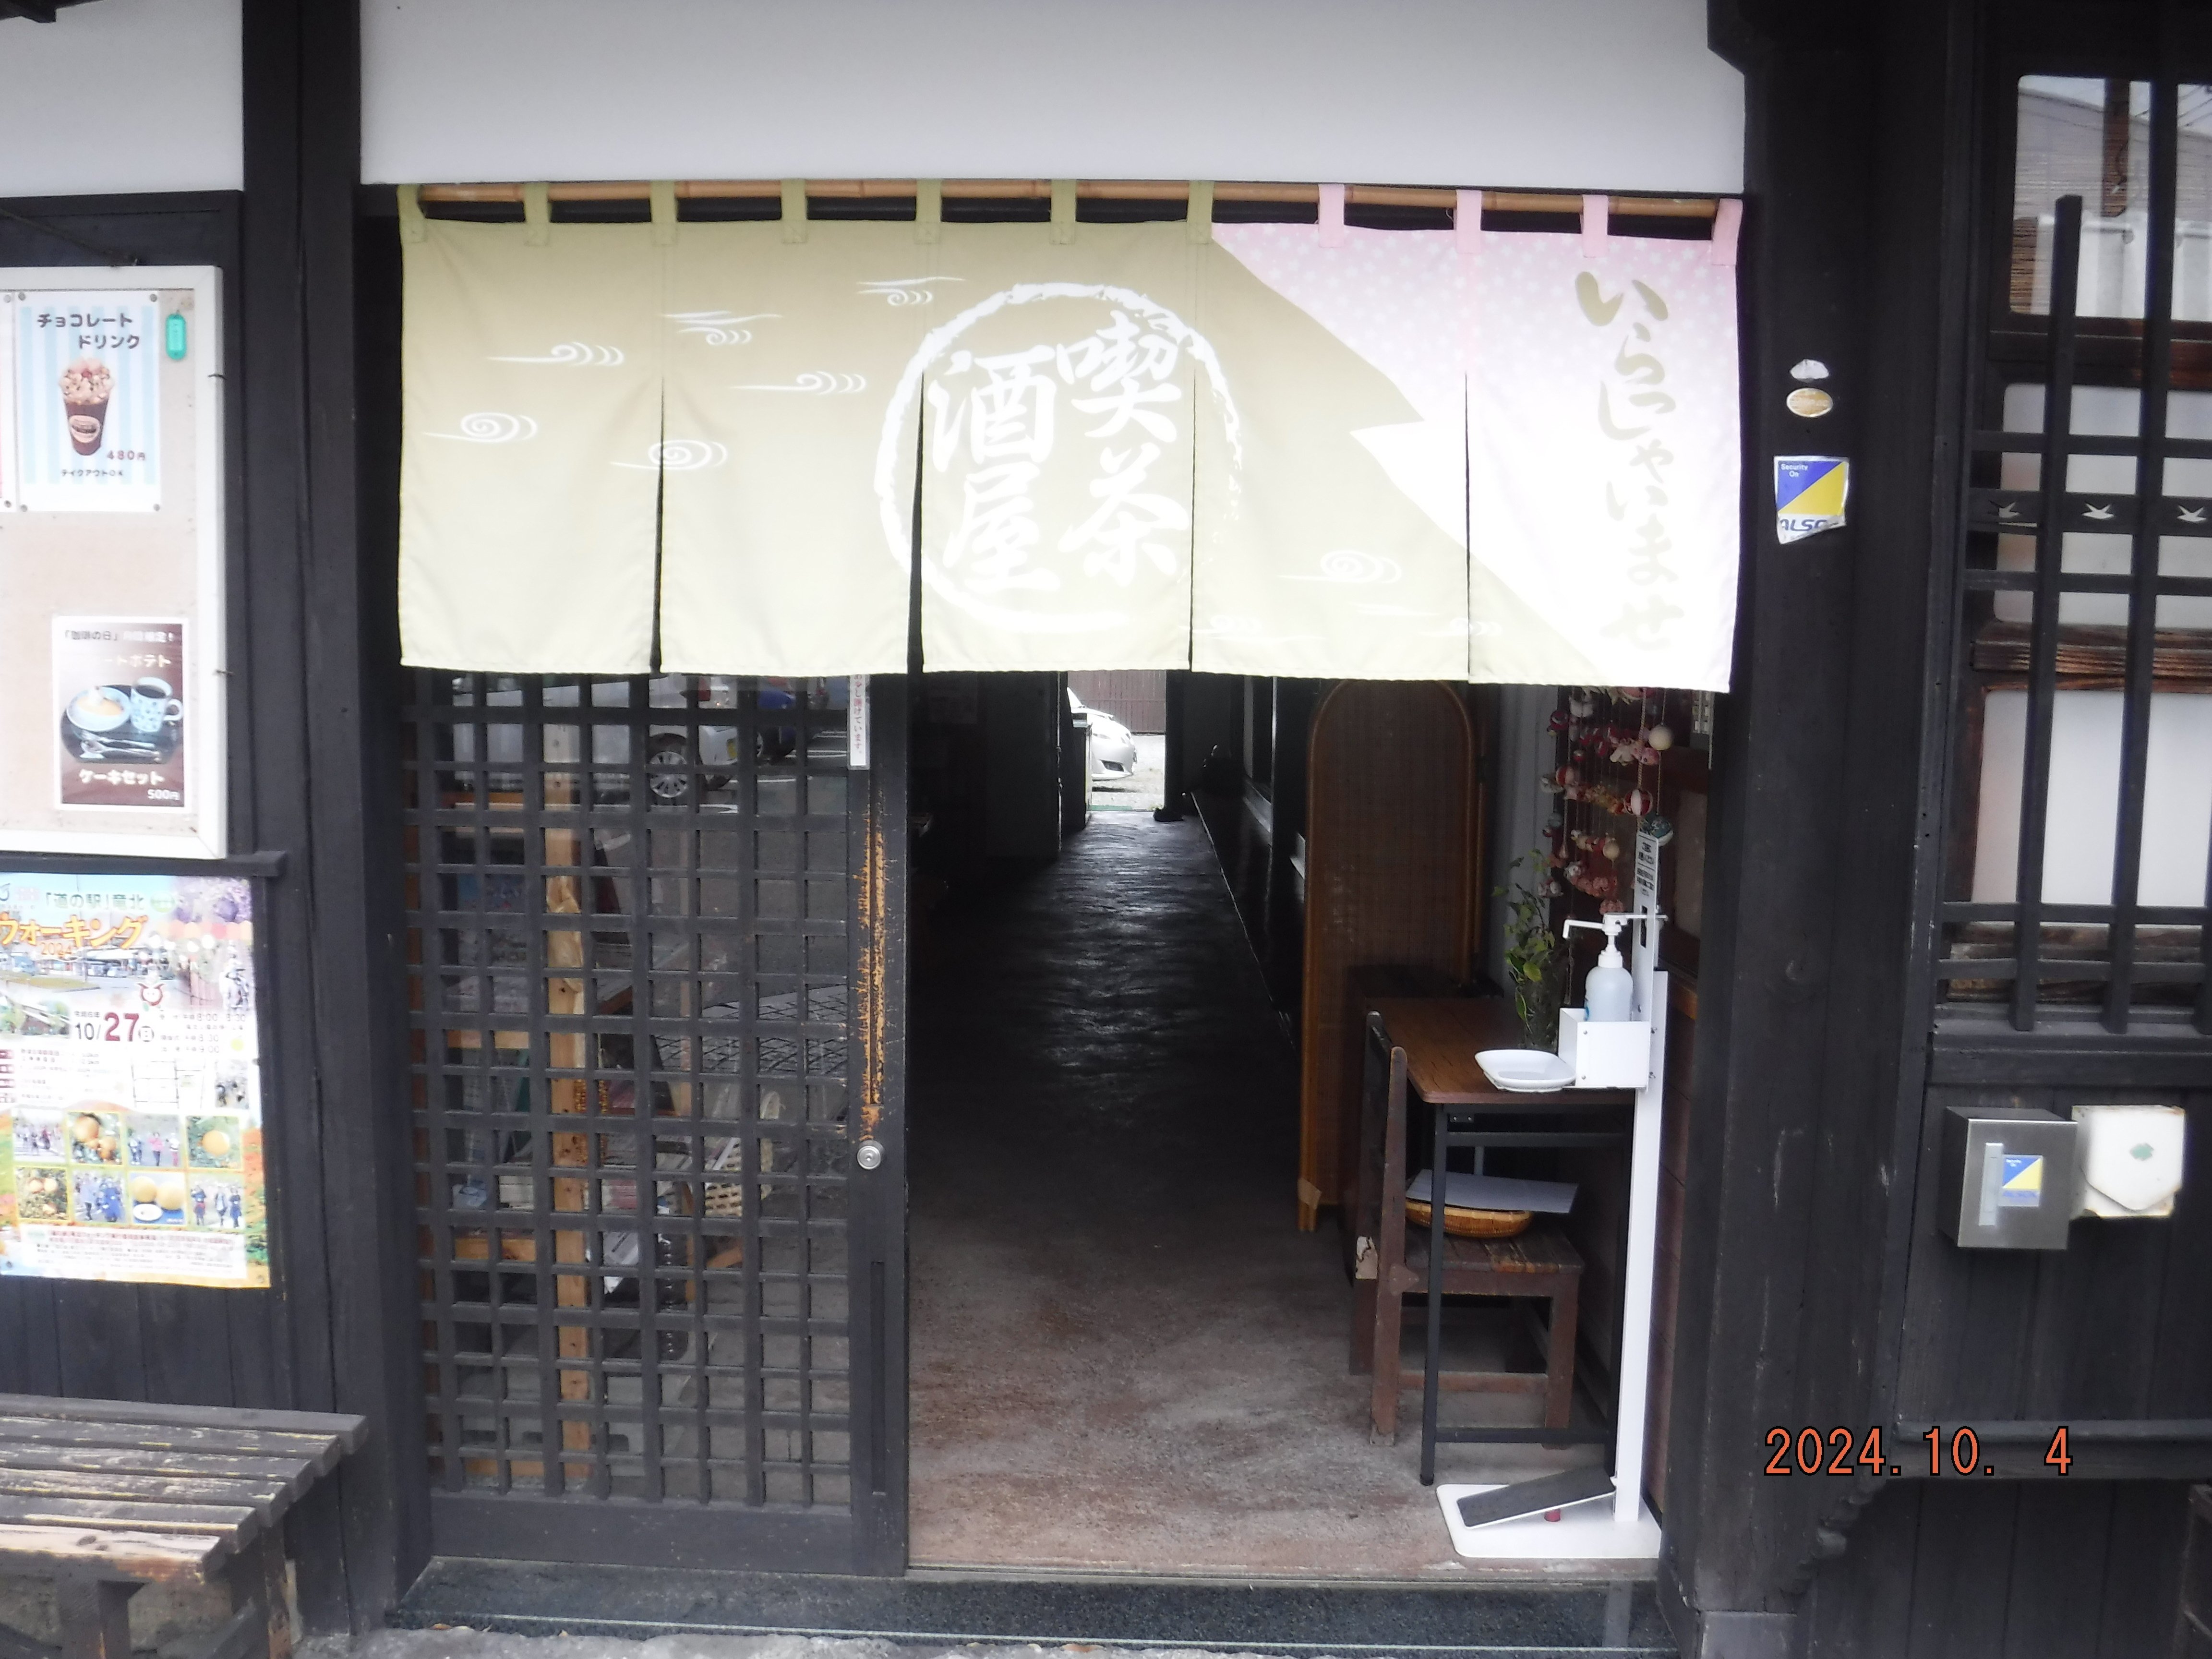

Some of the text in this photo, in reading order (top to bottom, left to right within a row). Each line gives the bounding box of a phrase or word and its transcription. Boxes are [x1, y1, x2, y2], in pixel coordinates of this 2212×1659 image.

[37, 313, 132, 328] チョコレート
[79, 335, 140, 349] ドリンク
[1056, 310, 1190, 586] 喫茶
[107, 450, 145, 461] 480円
[1575, 271, 1684, 650] いらっしゃいませ
[927, 345, 1060, 590] 酒屋
[1780, 463, 1808, 472] Security
[79, 769, 165, 785] ケーキセット
[147, 789, 180, 801] 500円
[41, 942, 74, 956] 2024
